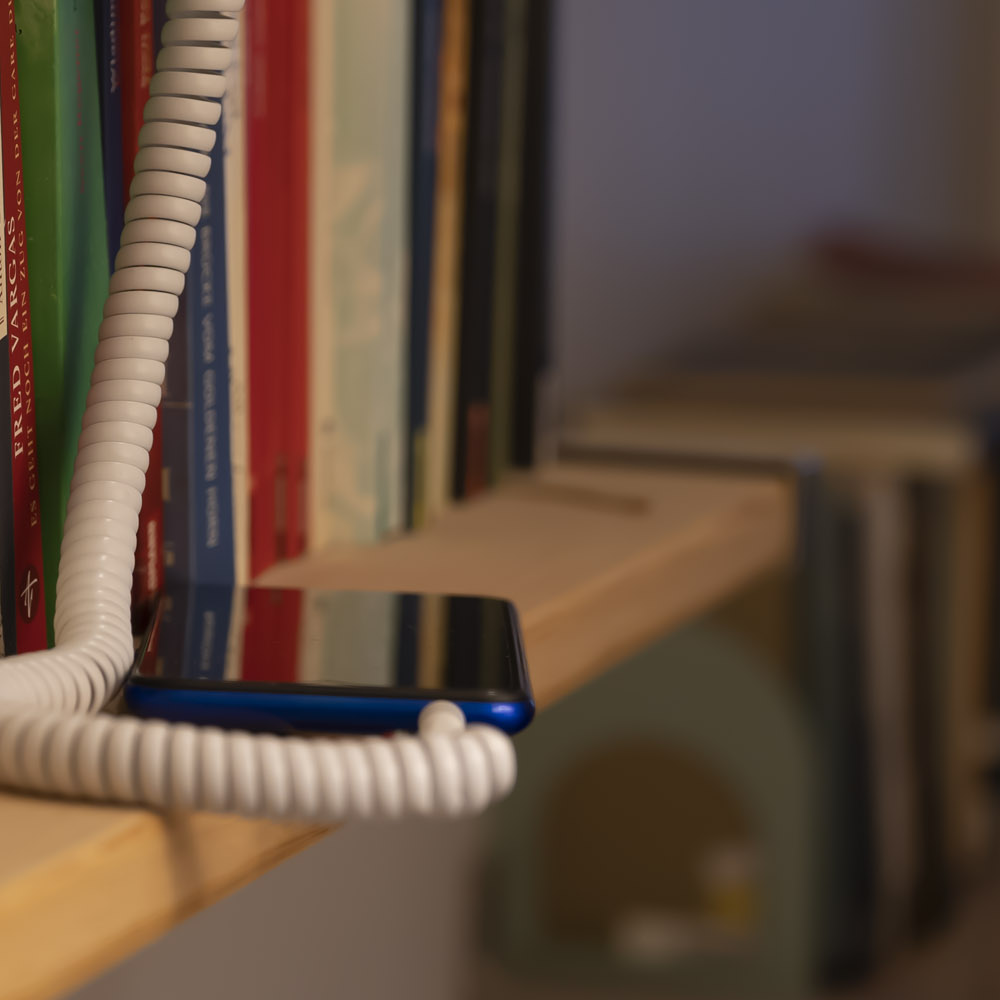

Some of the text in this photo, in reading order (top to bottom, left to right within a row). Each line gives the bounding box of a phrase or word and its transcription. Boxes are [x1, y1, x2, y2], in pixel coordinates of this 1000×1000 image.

[18, 230, 26, 281] ZUG
[7, 216, 24, 459] FRED VARGAS
[20, 291, 28, 333] EIN
[23, 344, 32, 415] NOCH
[26, 426, 36, 491] GEHT
[29, 500, 38, 528] ES
